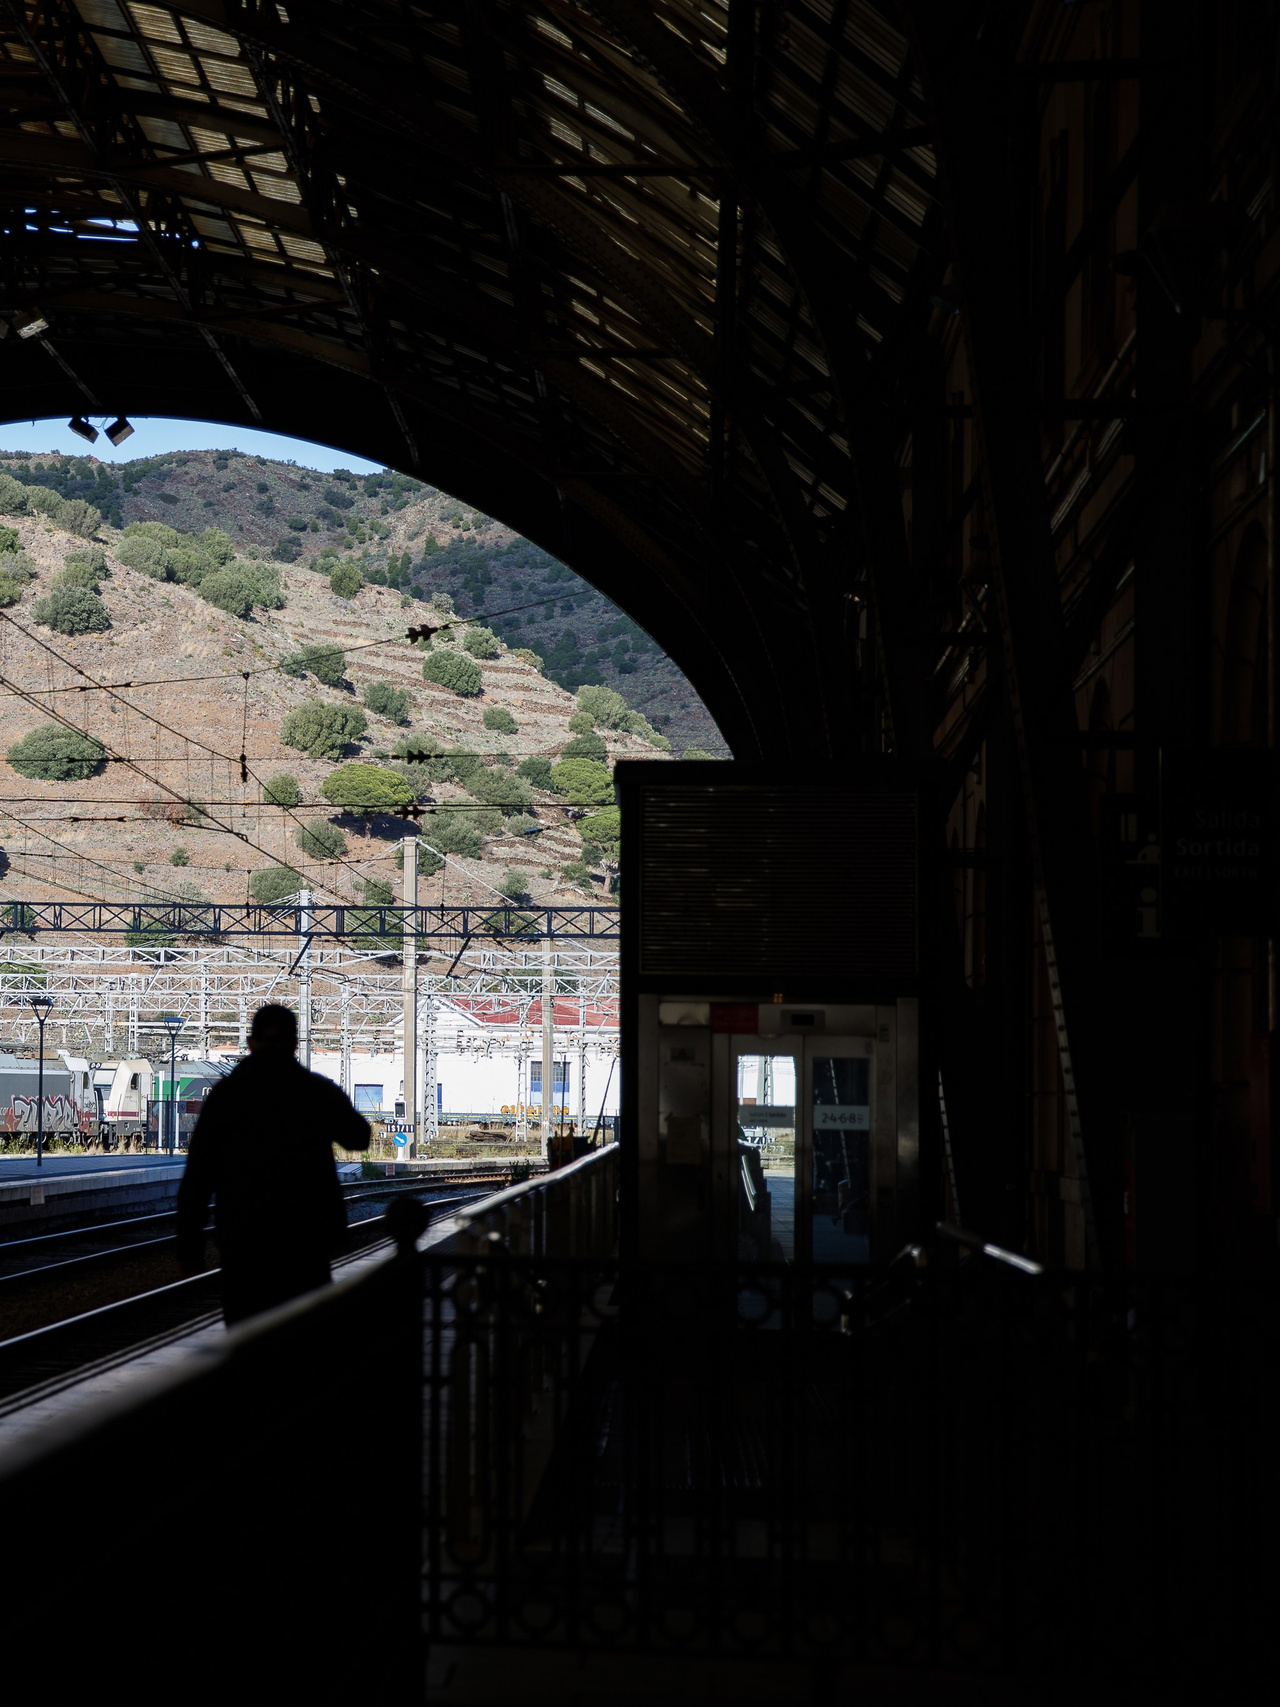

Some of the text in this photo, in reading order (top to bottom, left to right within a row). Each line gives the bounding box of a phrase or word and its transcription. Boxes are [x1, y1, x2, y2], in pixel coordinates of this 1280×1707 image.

[1195, 809, 1261, 829] Salida
[1176, 837, 1260, 857] Sortida
[1174, 866, 1260, 878] EXIT SORTIE
